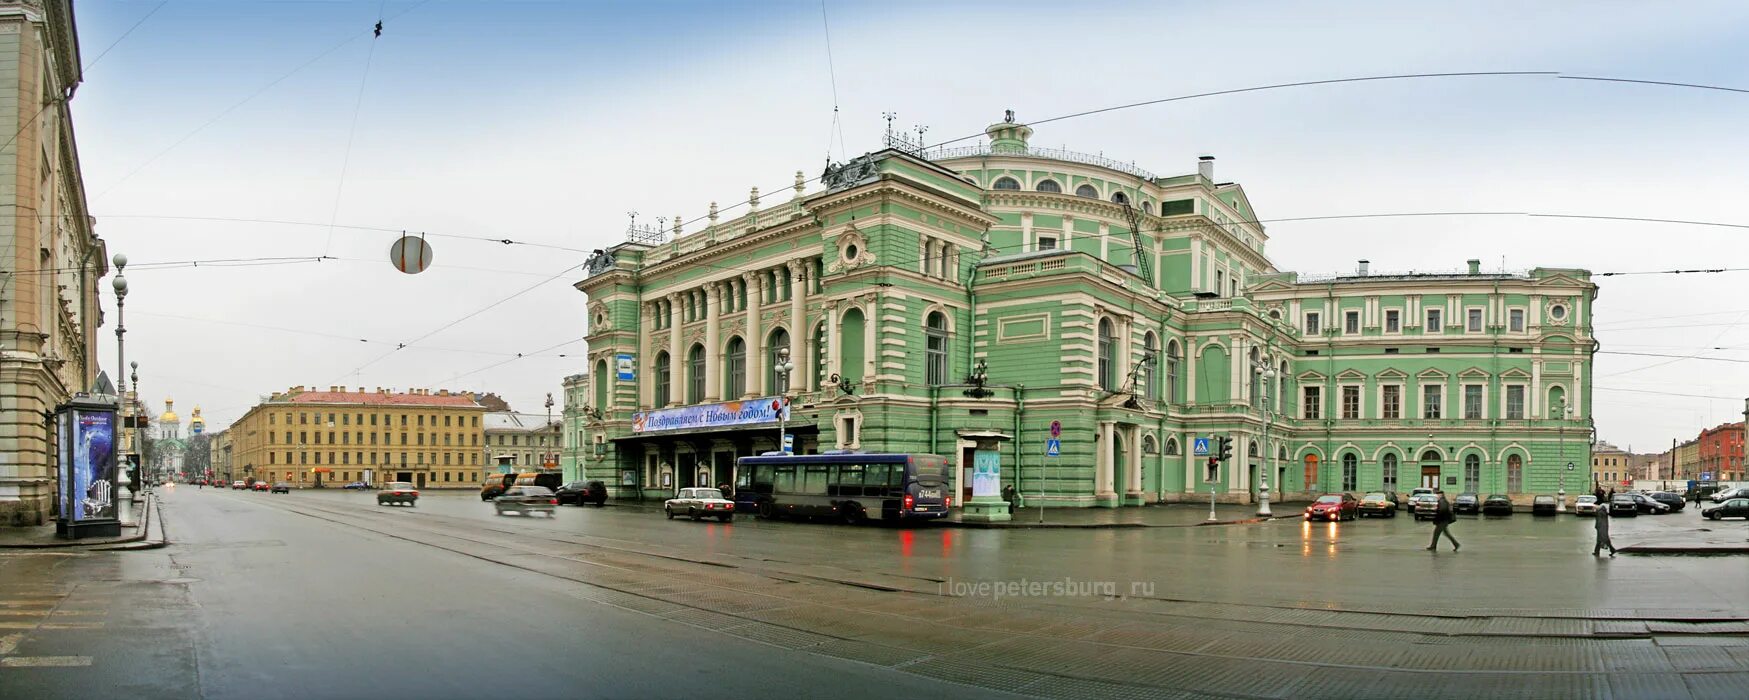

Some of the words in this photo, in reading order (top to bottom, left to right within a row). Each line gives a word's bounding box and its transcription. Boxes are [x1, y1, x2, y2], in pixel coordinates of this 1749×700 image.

[648, 414, 697, 429] Поздравляем
[706, 411, 736, 423] Новым
[738, 405, 770, 420] годом!
